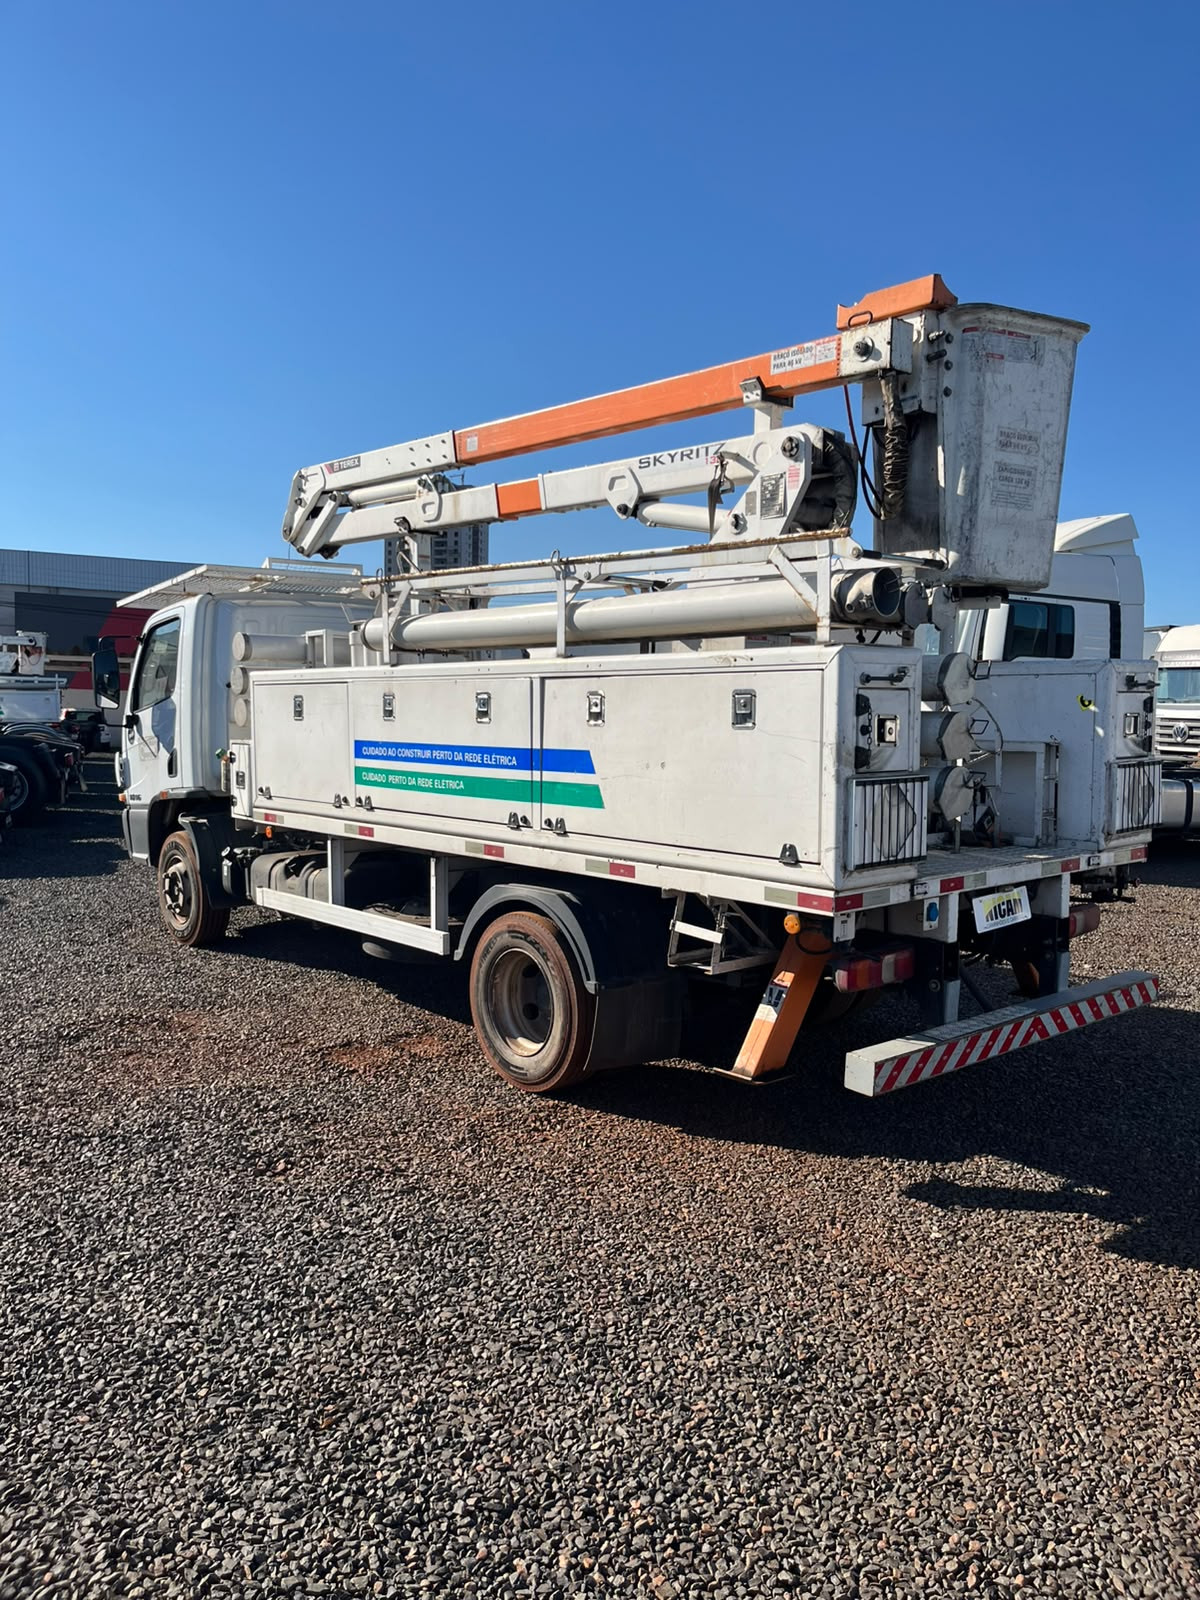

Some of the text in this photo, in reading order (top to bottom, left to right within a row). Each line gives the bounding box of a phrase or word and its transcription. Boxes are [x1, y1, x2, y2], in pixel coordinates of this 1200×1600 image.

[772, 360, 787, 370] PARA
[339, 457, 360, 470] TEREX
[637, 441, 727, 470] SKYRITZ
[361, 745, 518, 767] CUIDADO AO CONSTRUIR PERTO DA REDE ELÉTRICA
[361, 771, 387, 783] CUIDADO
[388, 774, 408, 785] PERTO
[407, 776, 417, 786] DA
[416, 777, 434, 788] REDE
